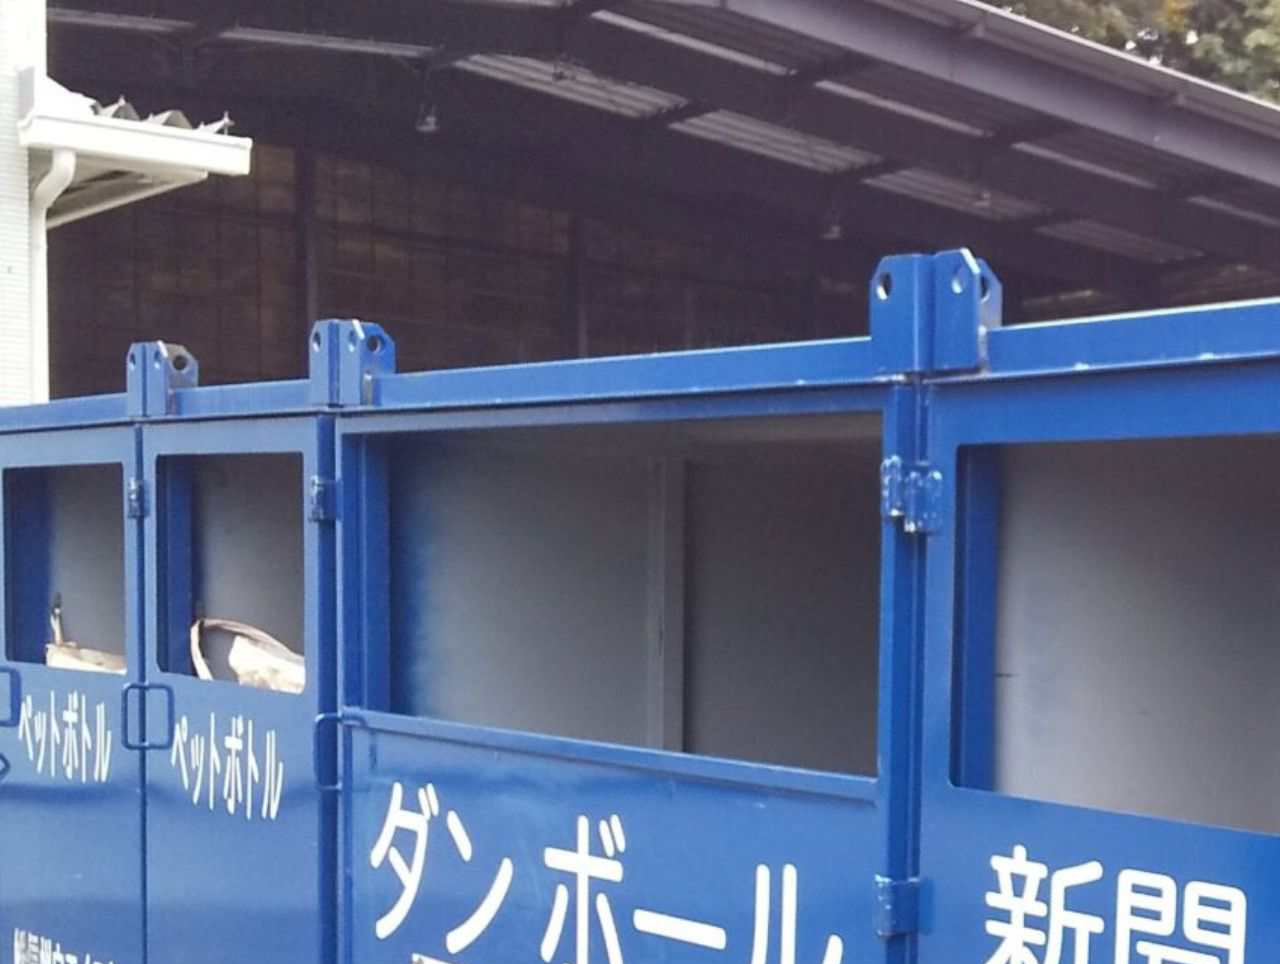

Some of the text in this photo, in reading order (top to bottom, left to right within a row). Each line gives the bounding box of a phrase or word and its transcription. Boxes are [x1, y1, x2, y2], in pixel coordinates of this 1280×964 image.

[19, 690, 112, 784] ペットボトル
[171, 711, 284, 820] ペットボトル
